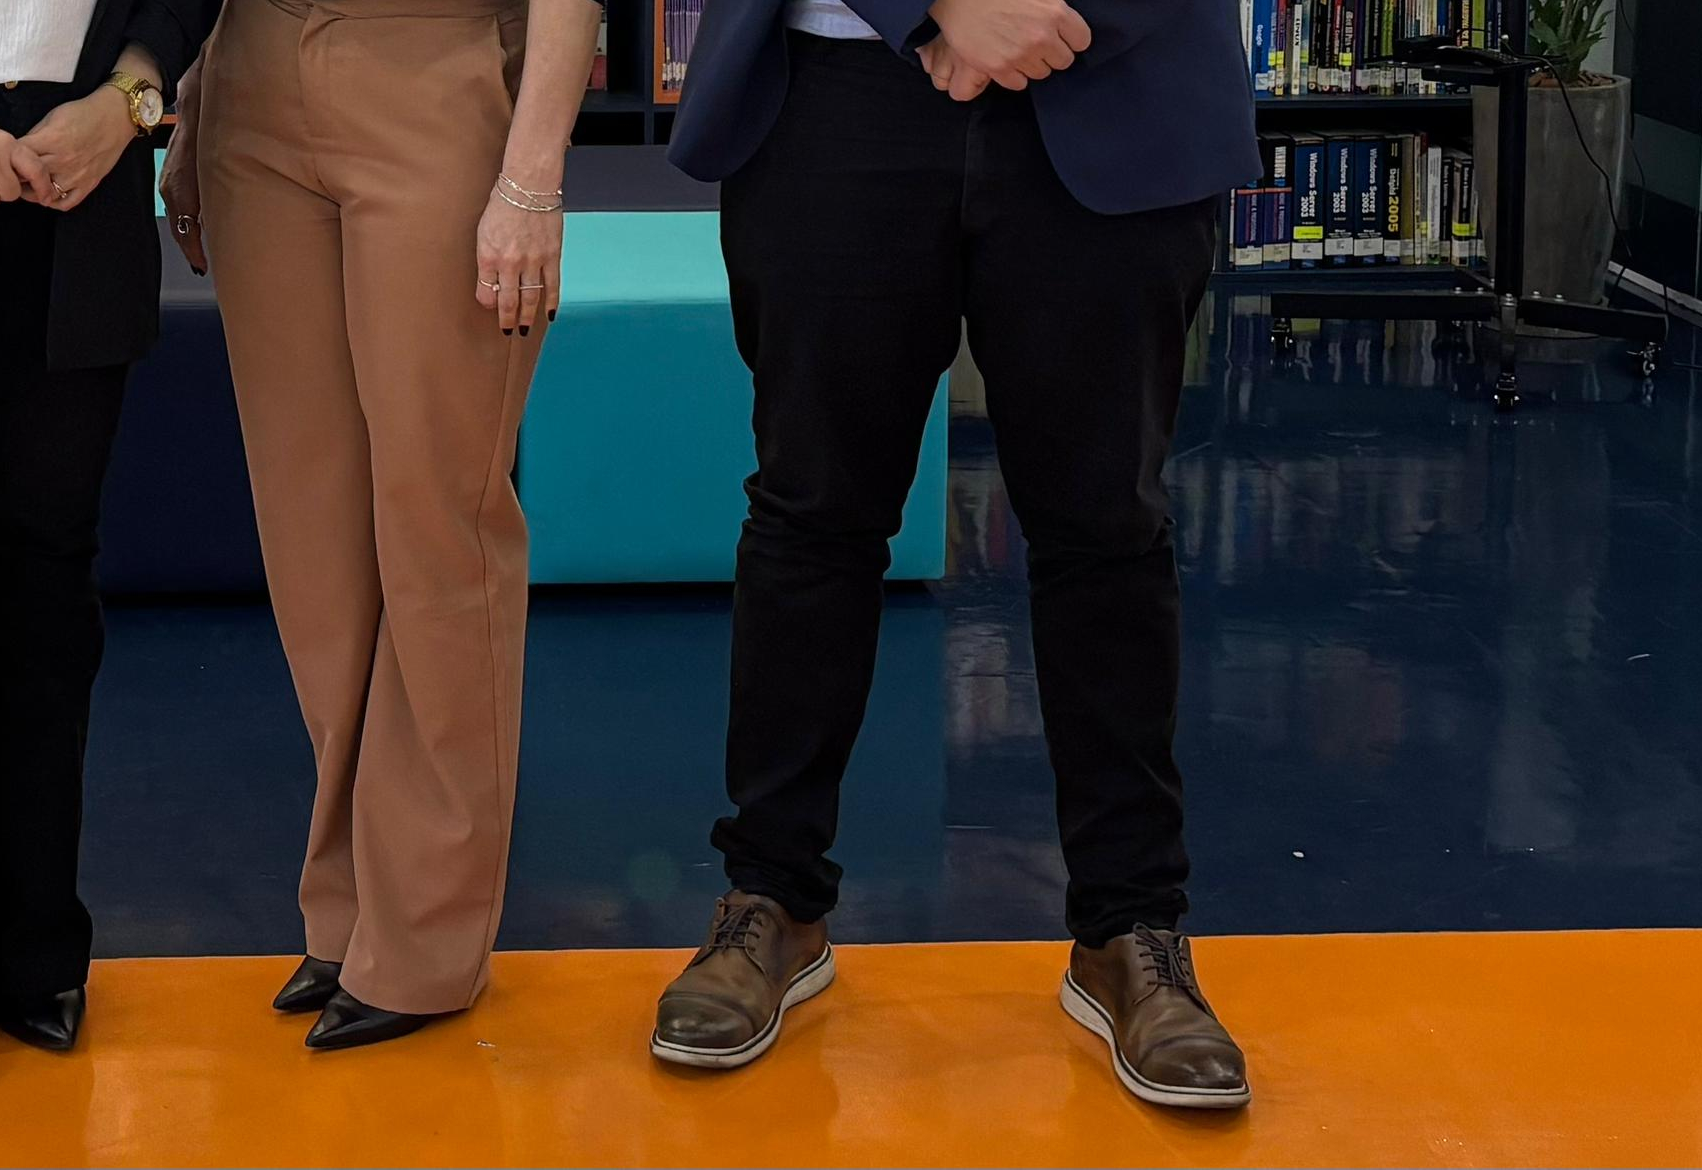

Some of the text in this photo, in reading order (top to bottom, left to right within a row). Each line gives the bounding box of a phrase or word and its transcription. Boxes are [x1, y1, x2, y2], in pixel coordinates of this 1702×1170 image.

[1309, 152, 1318, 217] Windows Server
[1340, 147, 1348, 213] Windows Server
[1369, 148, 1377, 213] Windows Server
[1300, 196, 1309, 218] 2003
[1332, 192, 1340, 213] 2003
[1361, 192, 1369, 213] 2003
[1388, 196, 1399, 232] 2005
